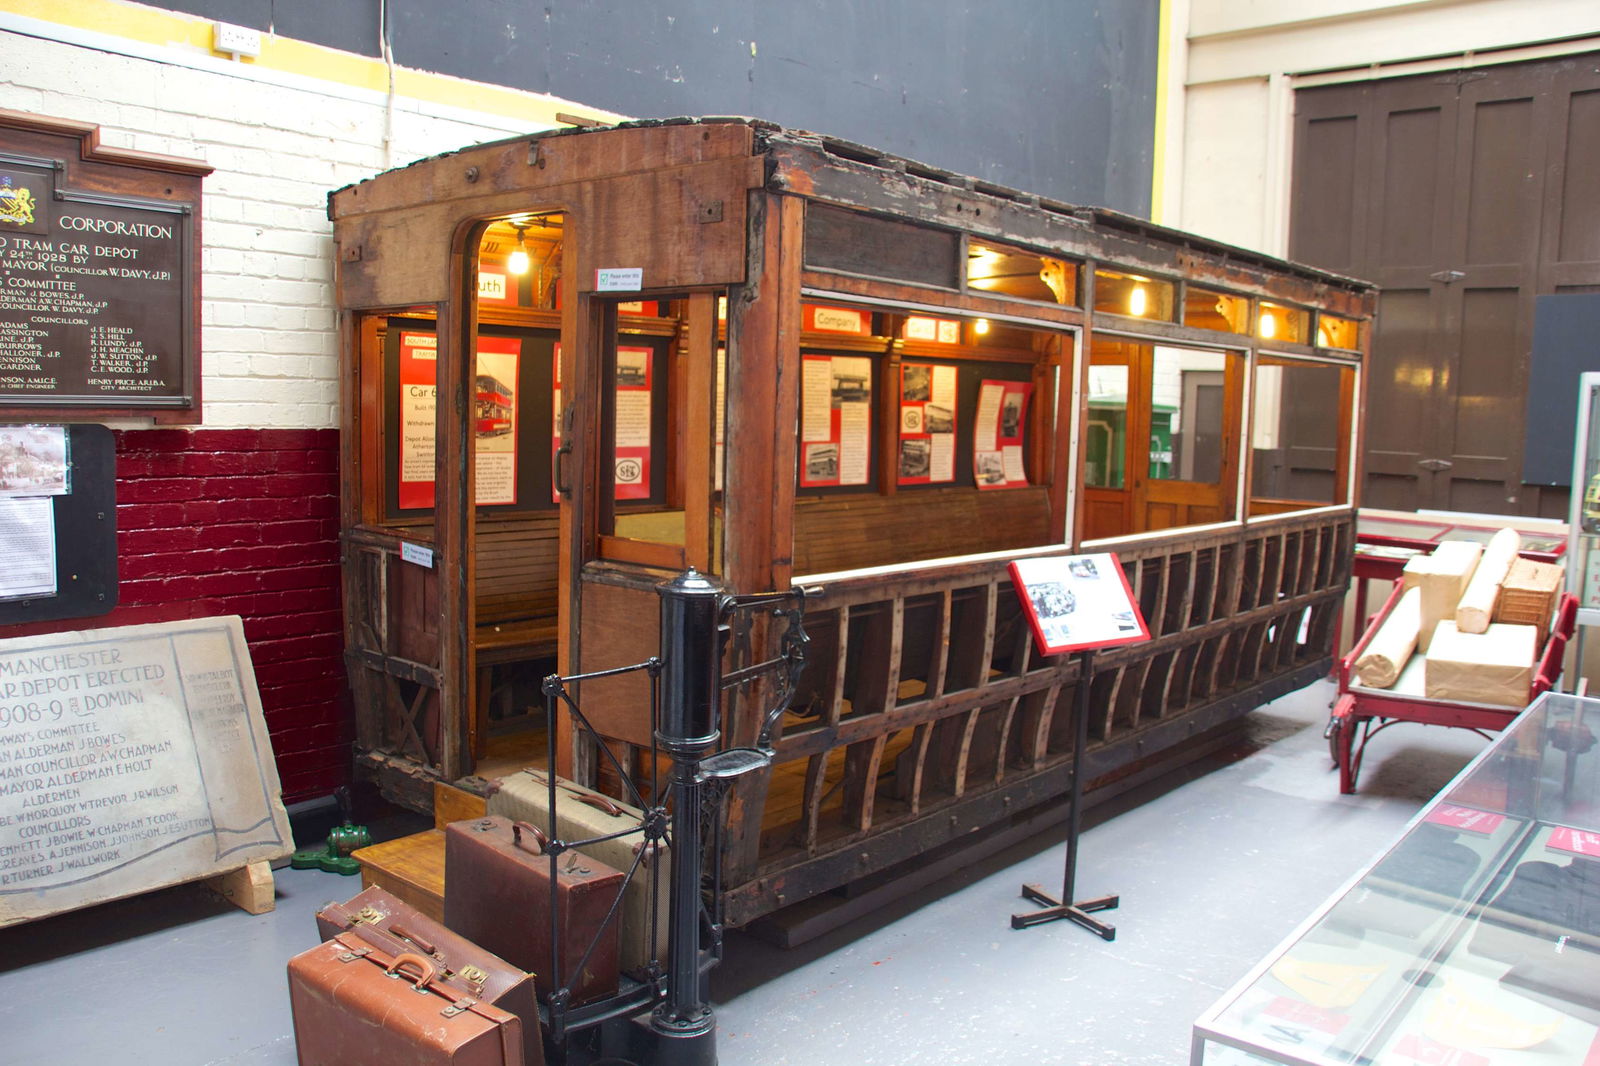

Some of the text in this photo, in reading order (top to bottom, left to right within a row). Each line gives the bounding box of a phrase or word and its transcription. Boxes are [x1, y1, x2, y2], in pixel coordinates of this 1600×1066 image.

[60, 216, 172, 239] CORPORATION
[13, 238, 53, 252] TRAM
[60, 243, 90, 255] CAR
[2, 260, 48, 271] MAYOR
[38, 252, 67, 262] 1928
[73, 255, 89, 265] BY
[8, 277, 77, 291] COMMITTEE
[0, 302, 50, 312] OUNCILLOR
[0, 321, 29, 330] ADAMS
[31, 316, 89, 325] COUNCILLORS
[817, 312, 856, 328] Company
[107, 327, 133, 335] HEALD
[107, 333, 125, 341] HILL
[0, 342, 42, 350] BURROWS
[0, 363, 42, 371] GARDNER
[410, 386, 428, 398] Car
[0, 648, 123, 678] MANCHESTER
[21, 673, 80, 698] DEPOT
[85, 664, 166, 689] ERECTED
[83, 689, 144, 712] DOMINI
[37, 722, 101, 741] COMMITTEE
[15, 741, 76, 761] ALDERMAN
[24, 753, 97, 776] COUNCILLOR
[47, 765, 115, 789] ALDERMAN
[22, 787, 81, 808] ALDERMEN
[18, 815, 91, 839] COUNCILLORS
